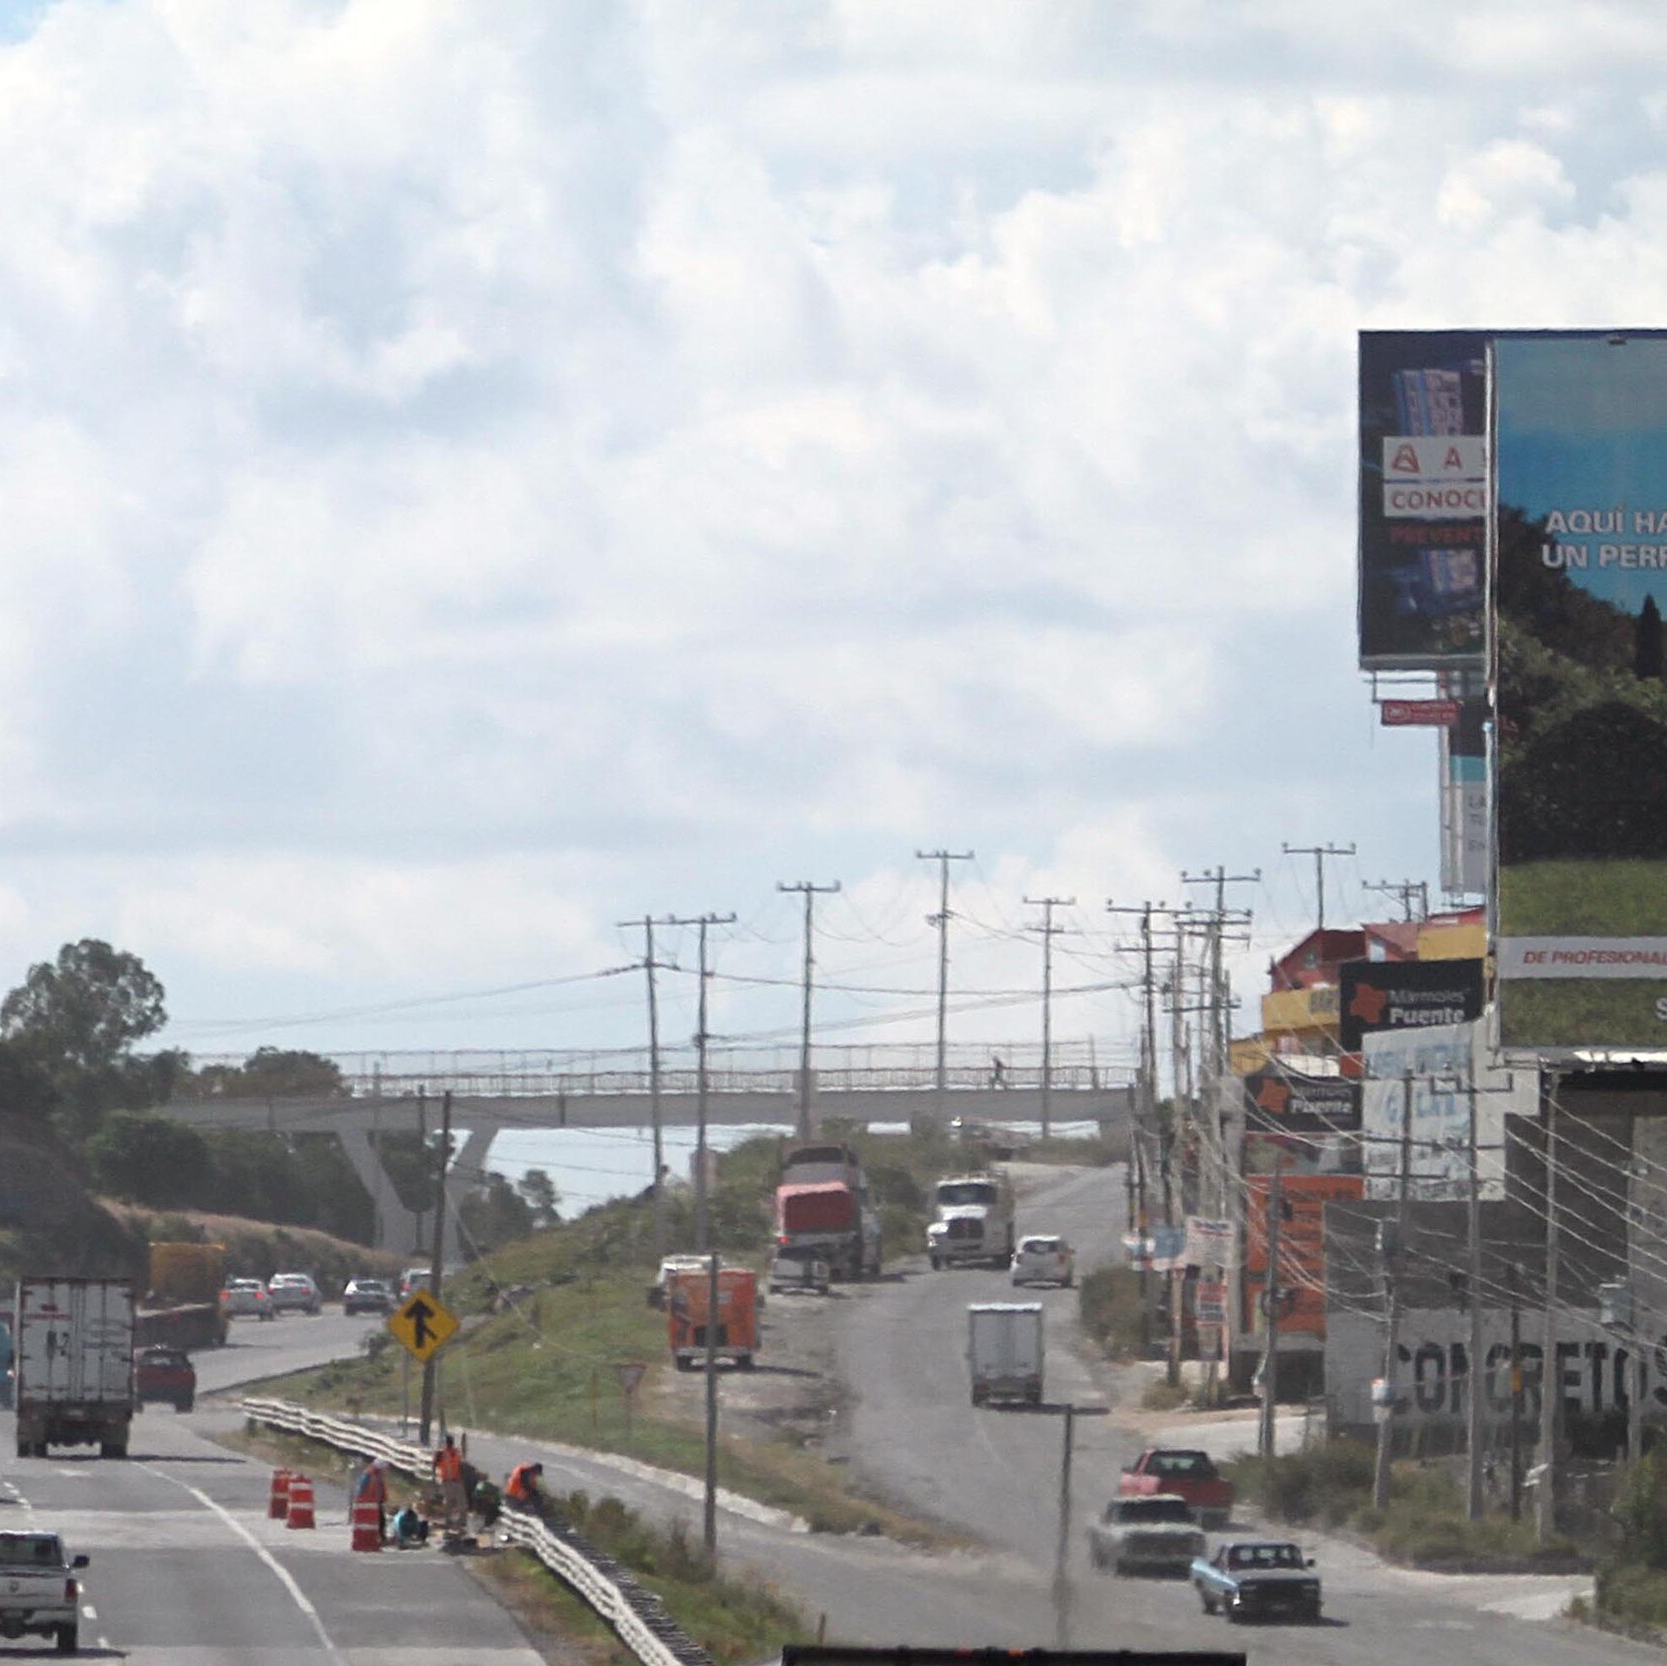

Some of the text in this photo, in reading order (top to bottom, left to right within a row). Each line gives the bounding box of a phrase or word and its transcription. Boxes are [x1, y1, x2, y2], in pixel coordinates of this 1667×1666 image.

[1391, 488, 1485, 510] CONOC
[1542, 544, 1587, 568] UN
[1389, 1006, 1465, 1026] Puente
